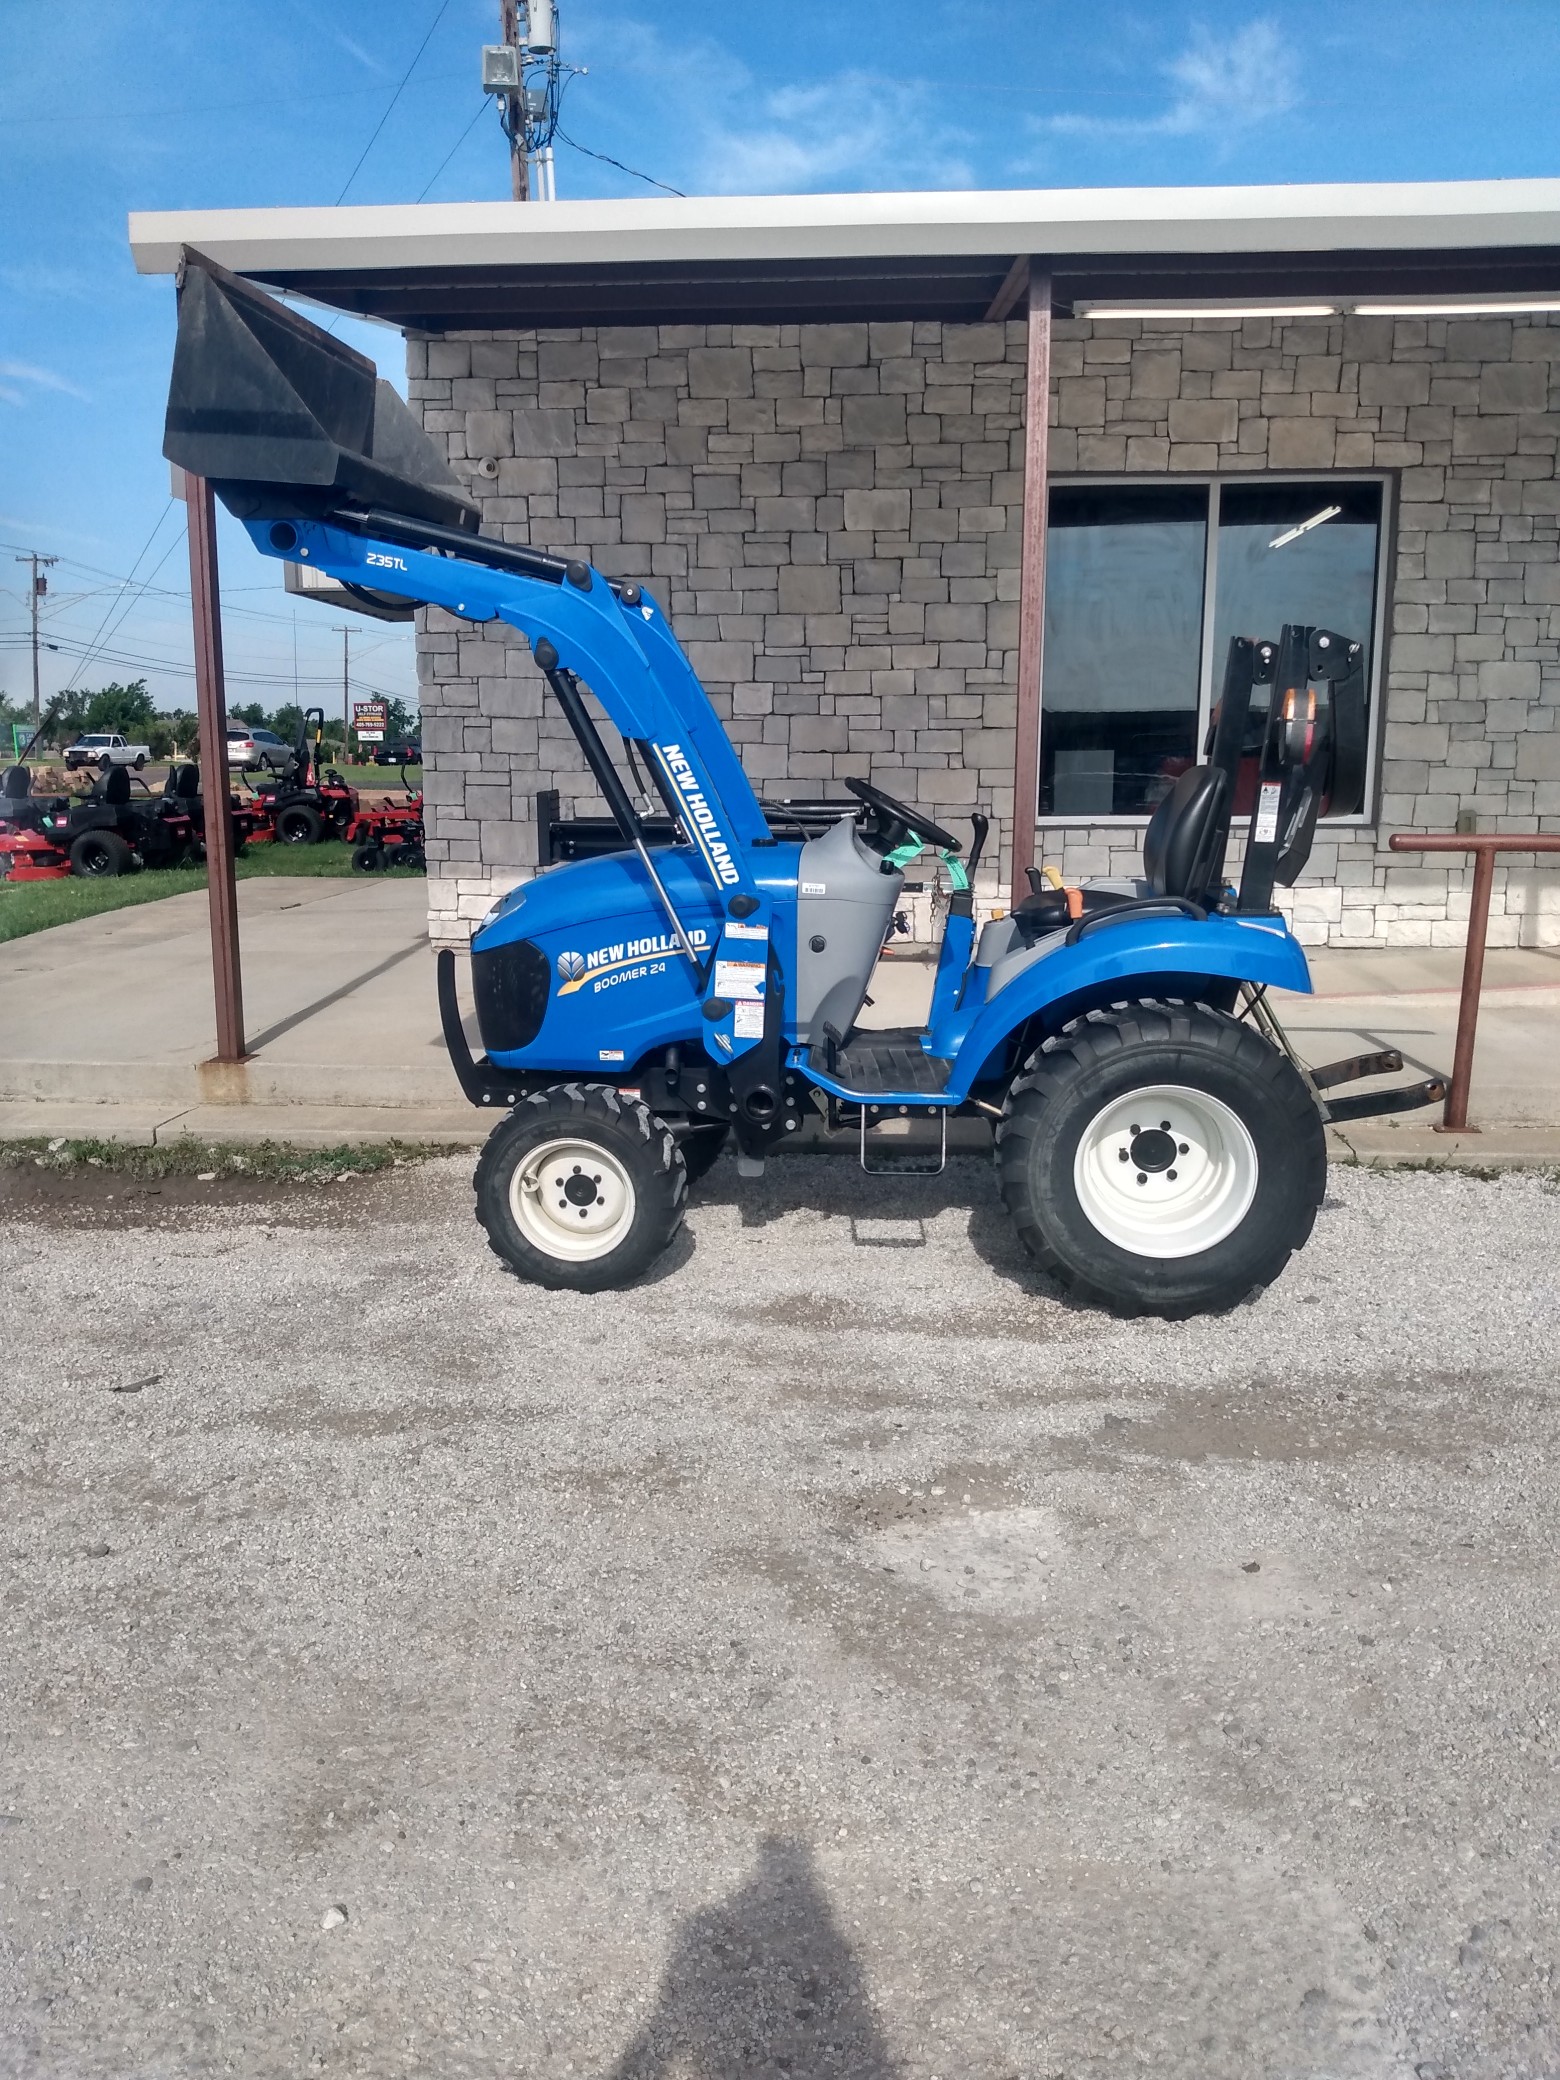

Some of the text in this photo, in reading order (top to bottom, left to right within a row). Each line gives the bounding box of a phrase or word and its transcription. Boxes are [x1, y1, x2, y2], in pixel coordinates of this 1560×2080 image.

[366, 552, 408, 571] 235TL
[662, 744, 740, 885] NEW HOLLAND
[587, 943, 624, 969] NEW
[594, 962, 666, 993] BOOMER 24
